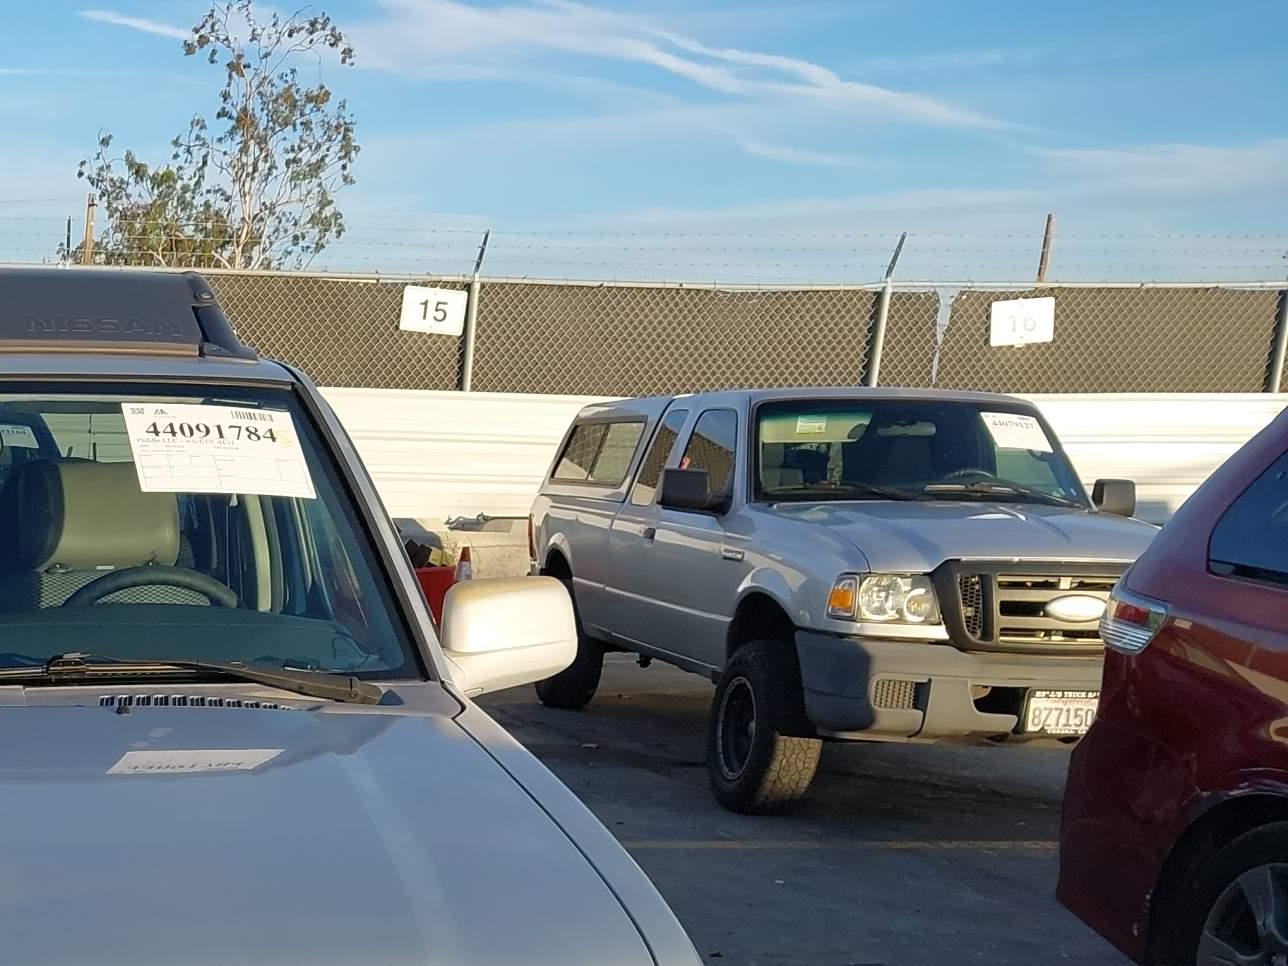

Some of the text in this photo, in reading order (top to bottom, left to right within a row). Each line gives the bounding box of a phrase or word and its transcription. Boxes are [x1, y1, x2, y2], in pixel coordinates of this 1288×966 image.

[420, 299, 448, 322] 15
[25, 315, 184, 336] NISSAN
[1009, 311, 1036, 333] 16
[146, 421, 277, 443] 44091784
